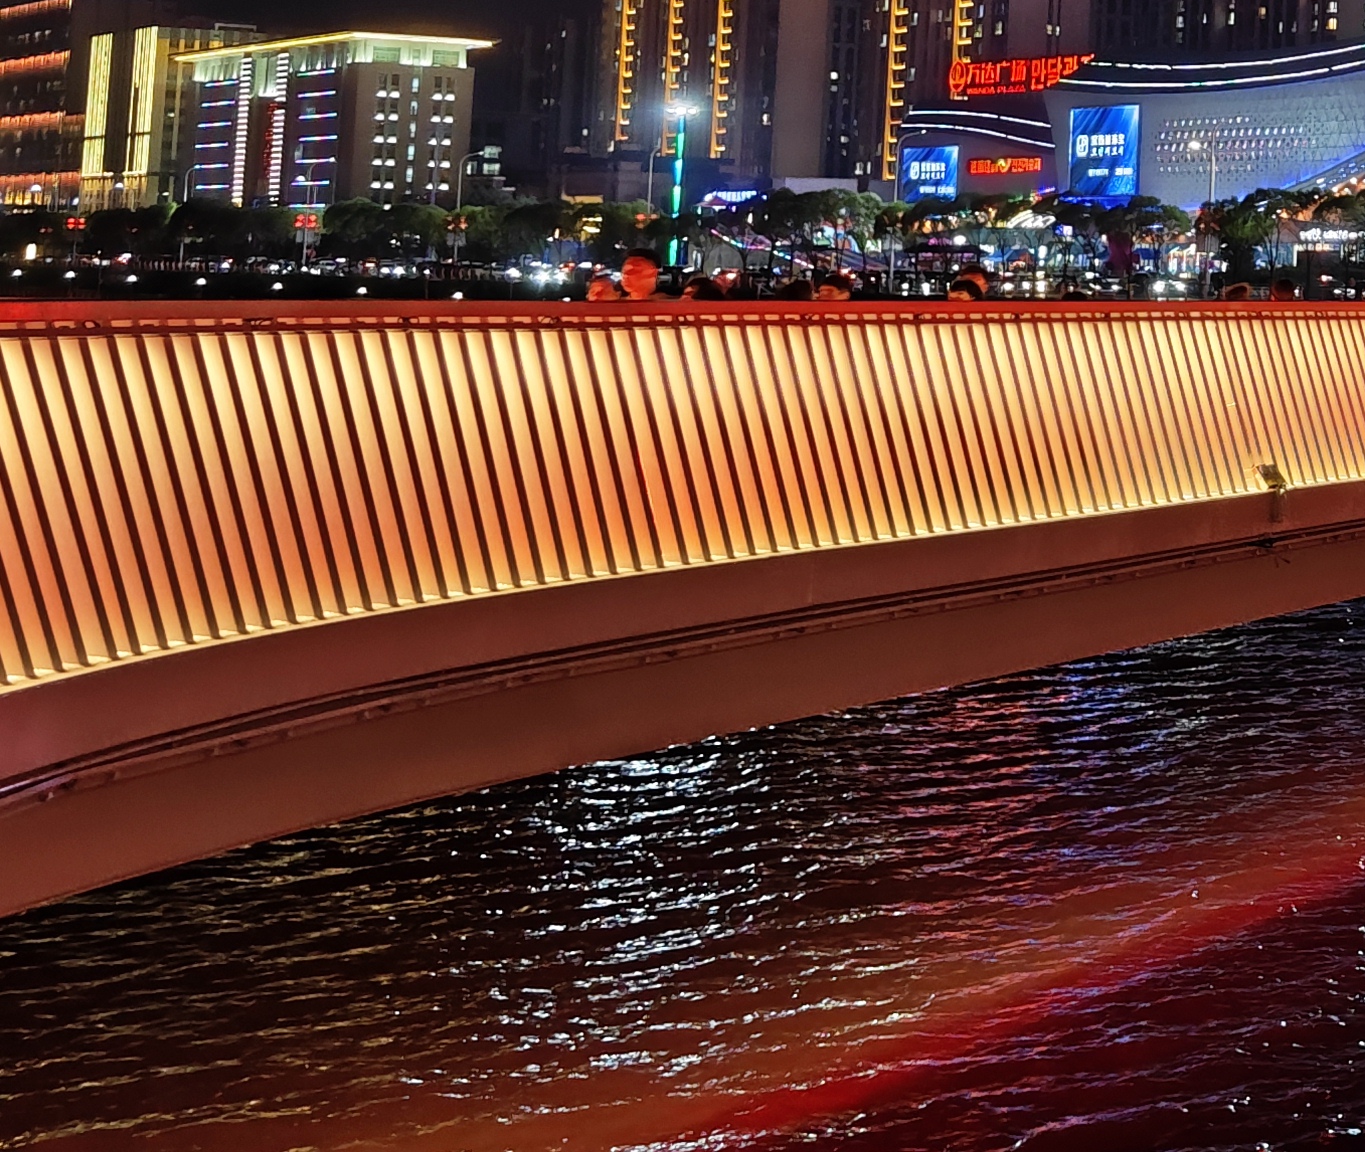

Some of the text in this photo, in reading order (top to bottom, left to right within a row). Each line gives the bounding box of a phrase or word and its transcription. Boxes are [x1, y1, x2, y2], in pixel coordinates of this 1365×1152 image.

[966, 60, 1027, 84] 万达广场
[966, 85, 996, 95] WANDA
